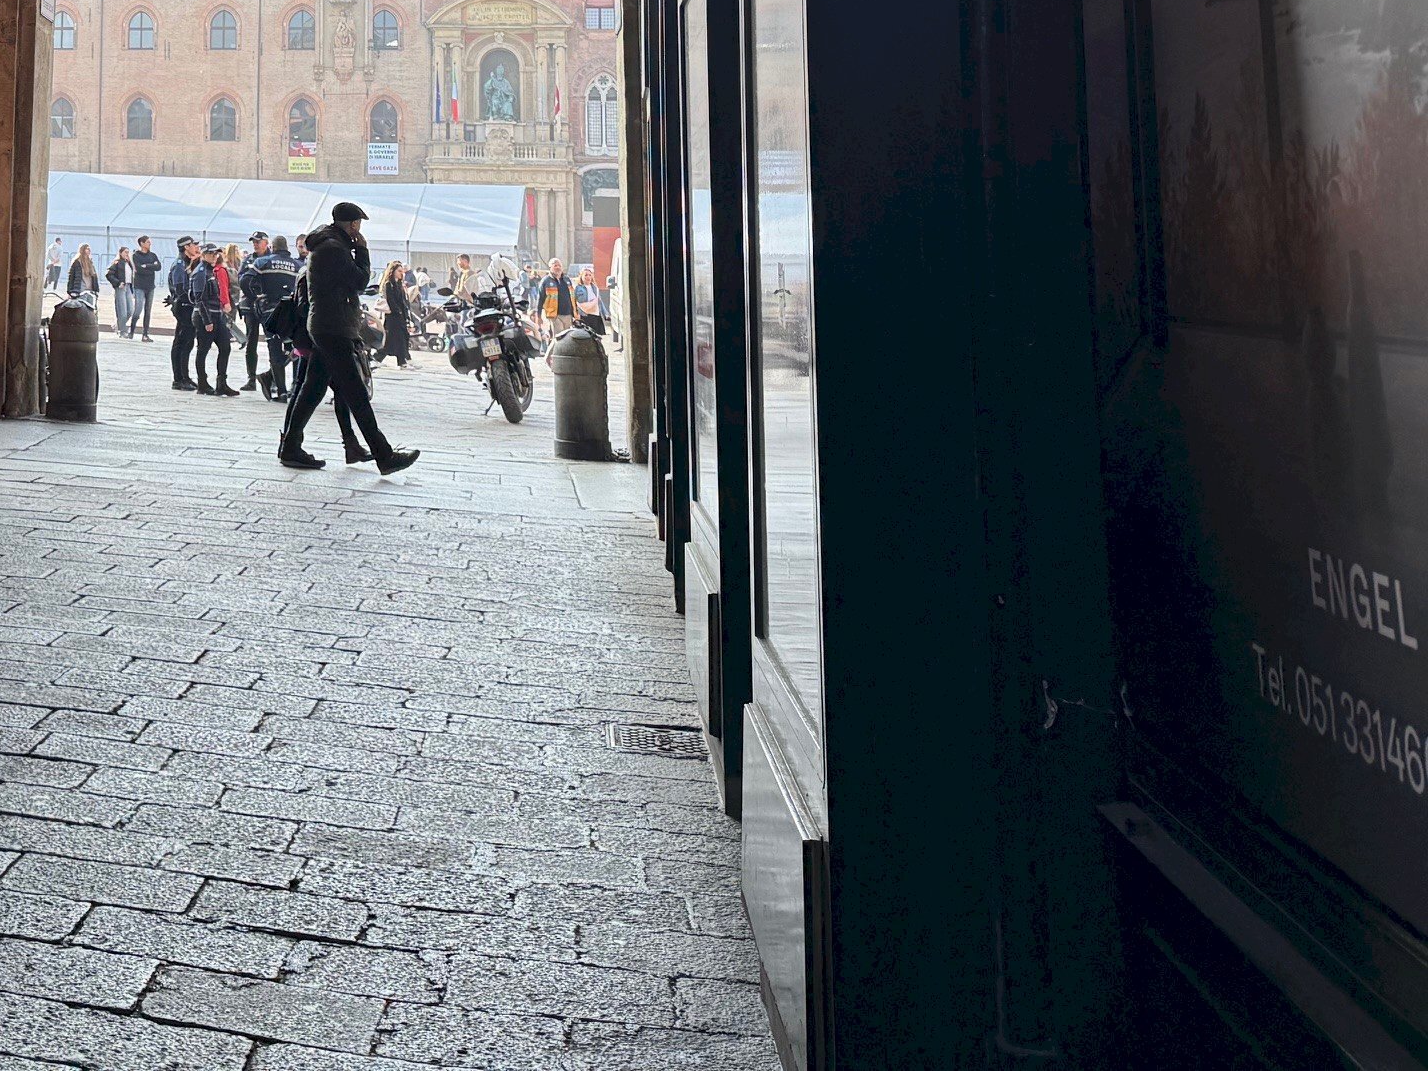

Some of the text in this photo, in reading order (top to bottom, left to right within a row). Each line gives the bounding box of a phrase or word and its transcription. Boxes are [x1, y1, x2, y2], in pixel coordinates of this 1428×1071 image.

[1307, 547, 1419, 650] ENGEL
[1251, 641, 1428, 795] Tel. 051 33146
